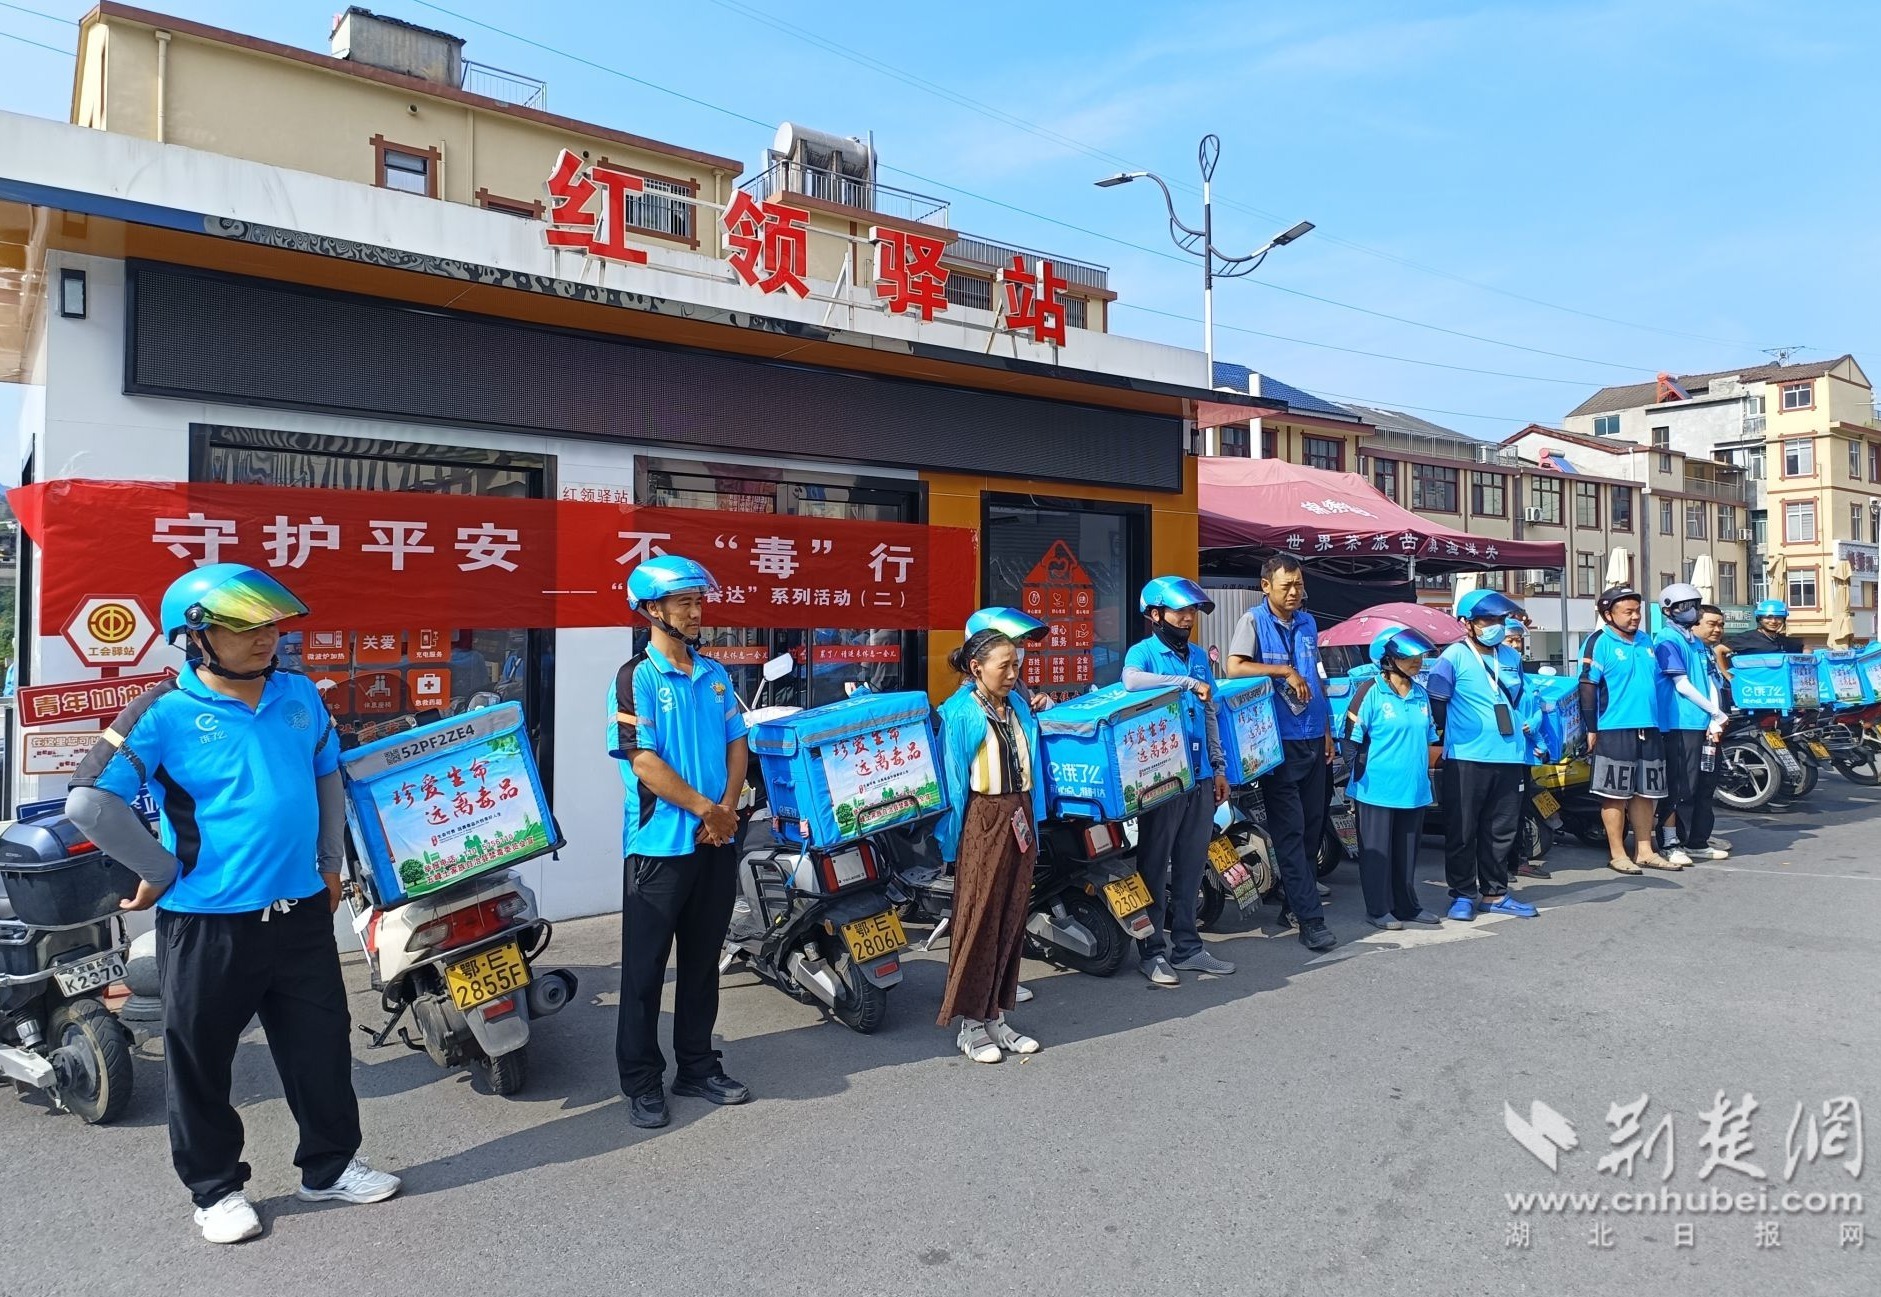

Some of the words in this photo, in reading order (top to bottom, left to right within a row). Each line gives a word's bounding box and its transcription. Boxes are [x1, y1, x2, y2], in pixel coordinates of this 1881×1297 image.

[545, 148, 1068, 347] 红领驿站
[562, 486, 629, 503] 红领驿站
[152, 512, 521, 572] 守护平安
[88, 647, 135, 657] 工会驿站
[362, 634, 396, 650] 关爱
[401, 723, 475, 759] 52PF2ZE4
[392, 757, 490, 810] 珍爱生命
[1061, 762, 1104, 784] 饿了么
[425, 778, 519, 825] 远离毒品
[1114, 887, 1151, 915] 2301J
[853, 929, 905, 960] 2806L
[65, 964, 124, 993] K2370
[457, 963, 521, 1007] 2855F
